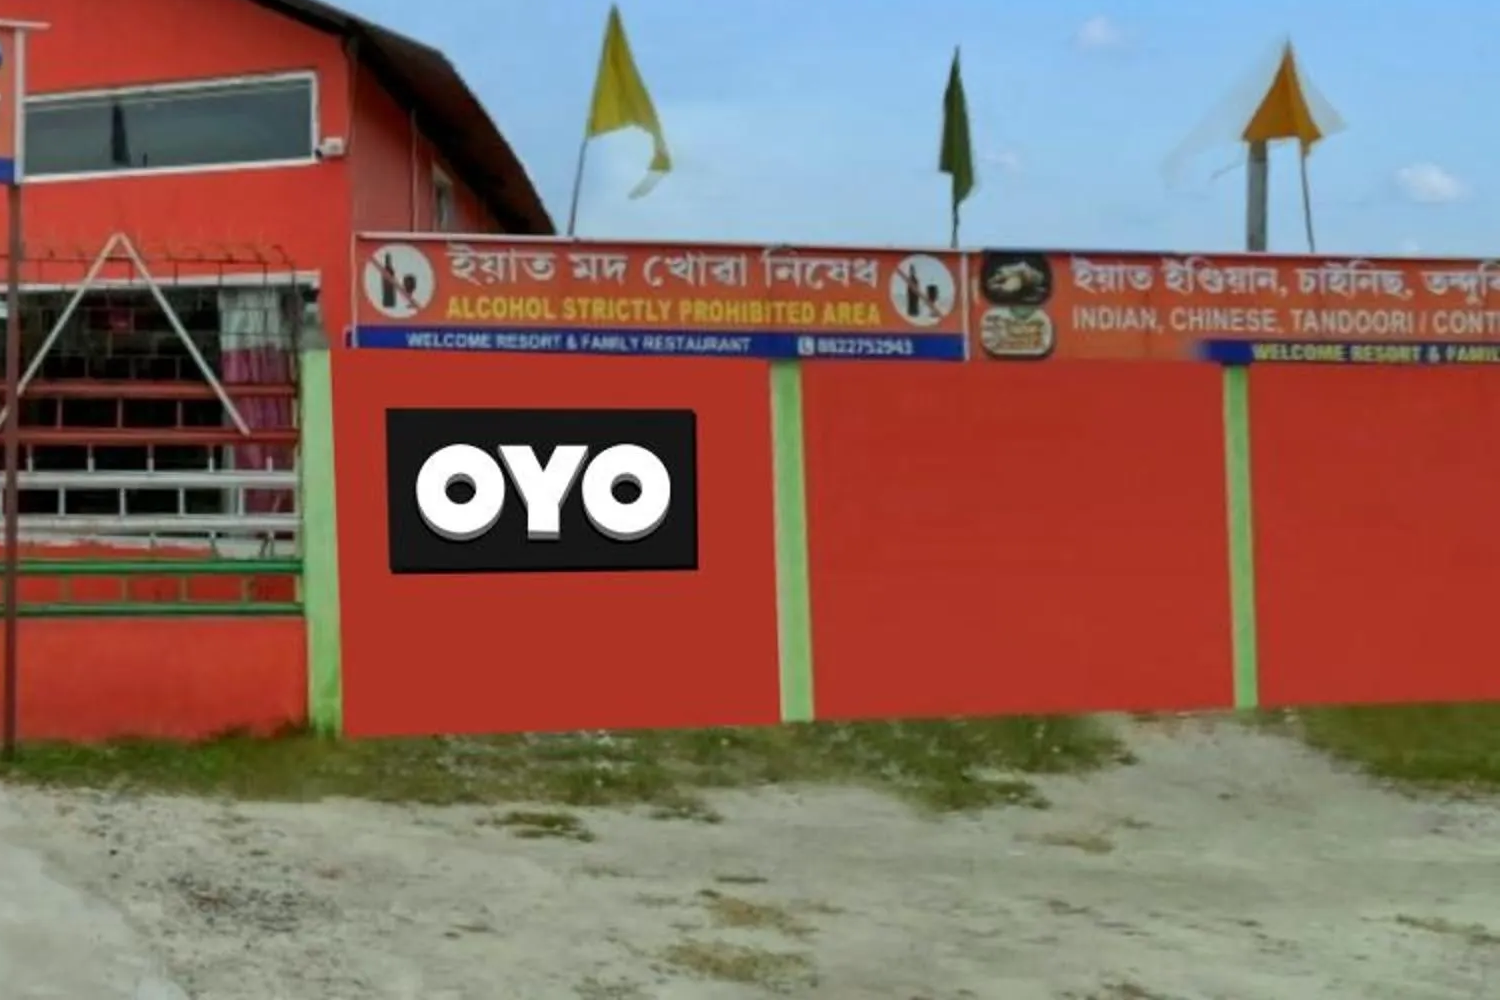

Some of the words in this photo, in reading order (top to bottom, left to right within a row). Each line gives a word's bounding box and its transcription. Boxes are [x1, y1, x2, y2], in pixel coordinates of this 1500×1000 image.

[446, 243, 556, 285] ইয়াত
[568, 253, 628, 286] মদ
[759, 247, 880, 289] নিষেধ
[446, 296, 556, 320] ALCOHOL
[562, 298, 672, 323] STRICTLY
[679, 300, 816, 326] PROHIBITED
[822, 302, 882, 327] AREA
[1072, 306, 1165, 335] INDIAN,
[1288, 308, 1414, 335] TANDOORI
[405, 331, 492, 348] WELCOME
[496, 333, 562, 350] RESORT
[580, 333, 639, 351] FAMILY
[641, 334, 752, 353] RESTAURANT
[1251, 343, 1347, 361] WELCOME
[415, 443, 671, 541] OYO
